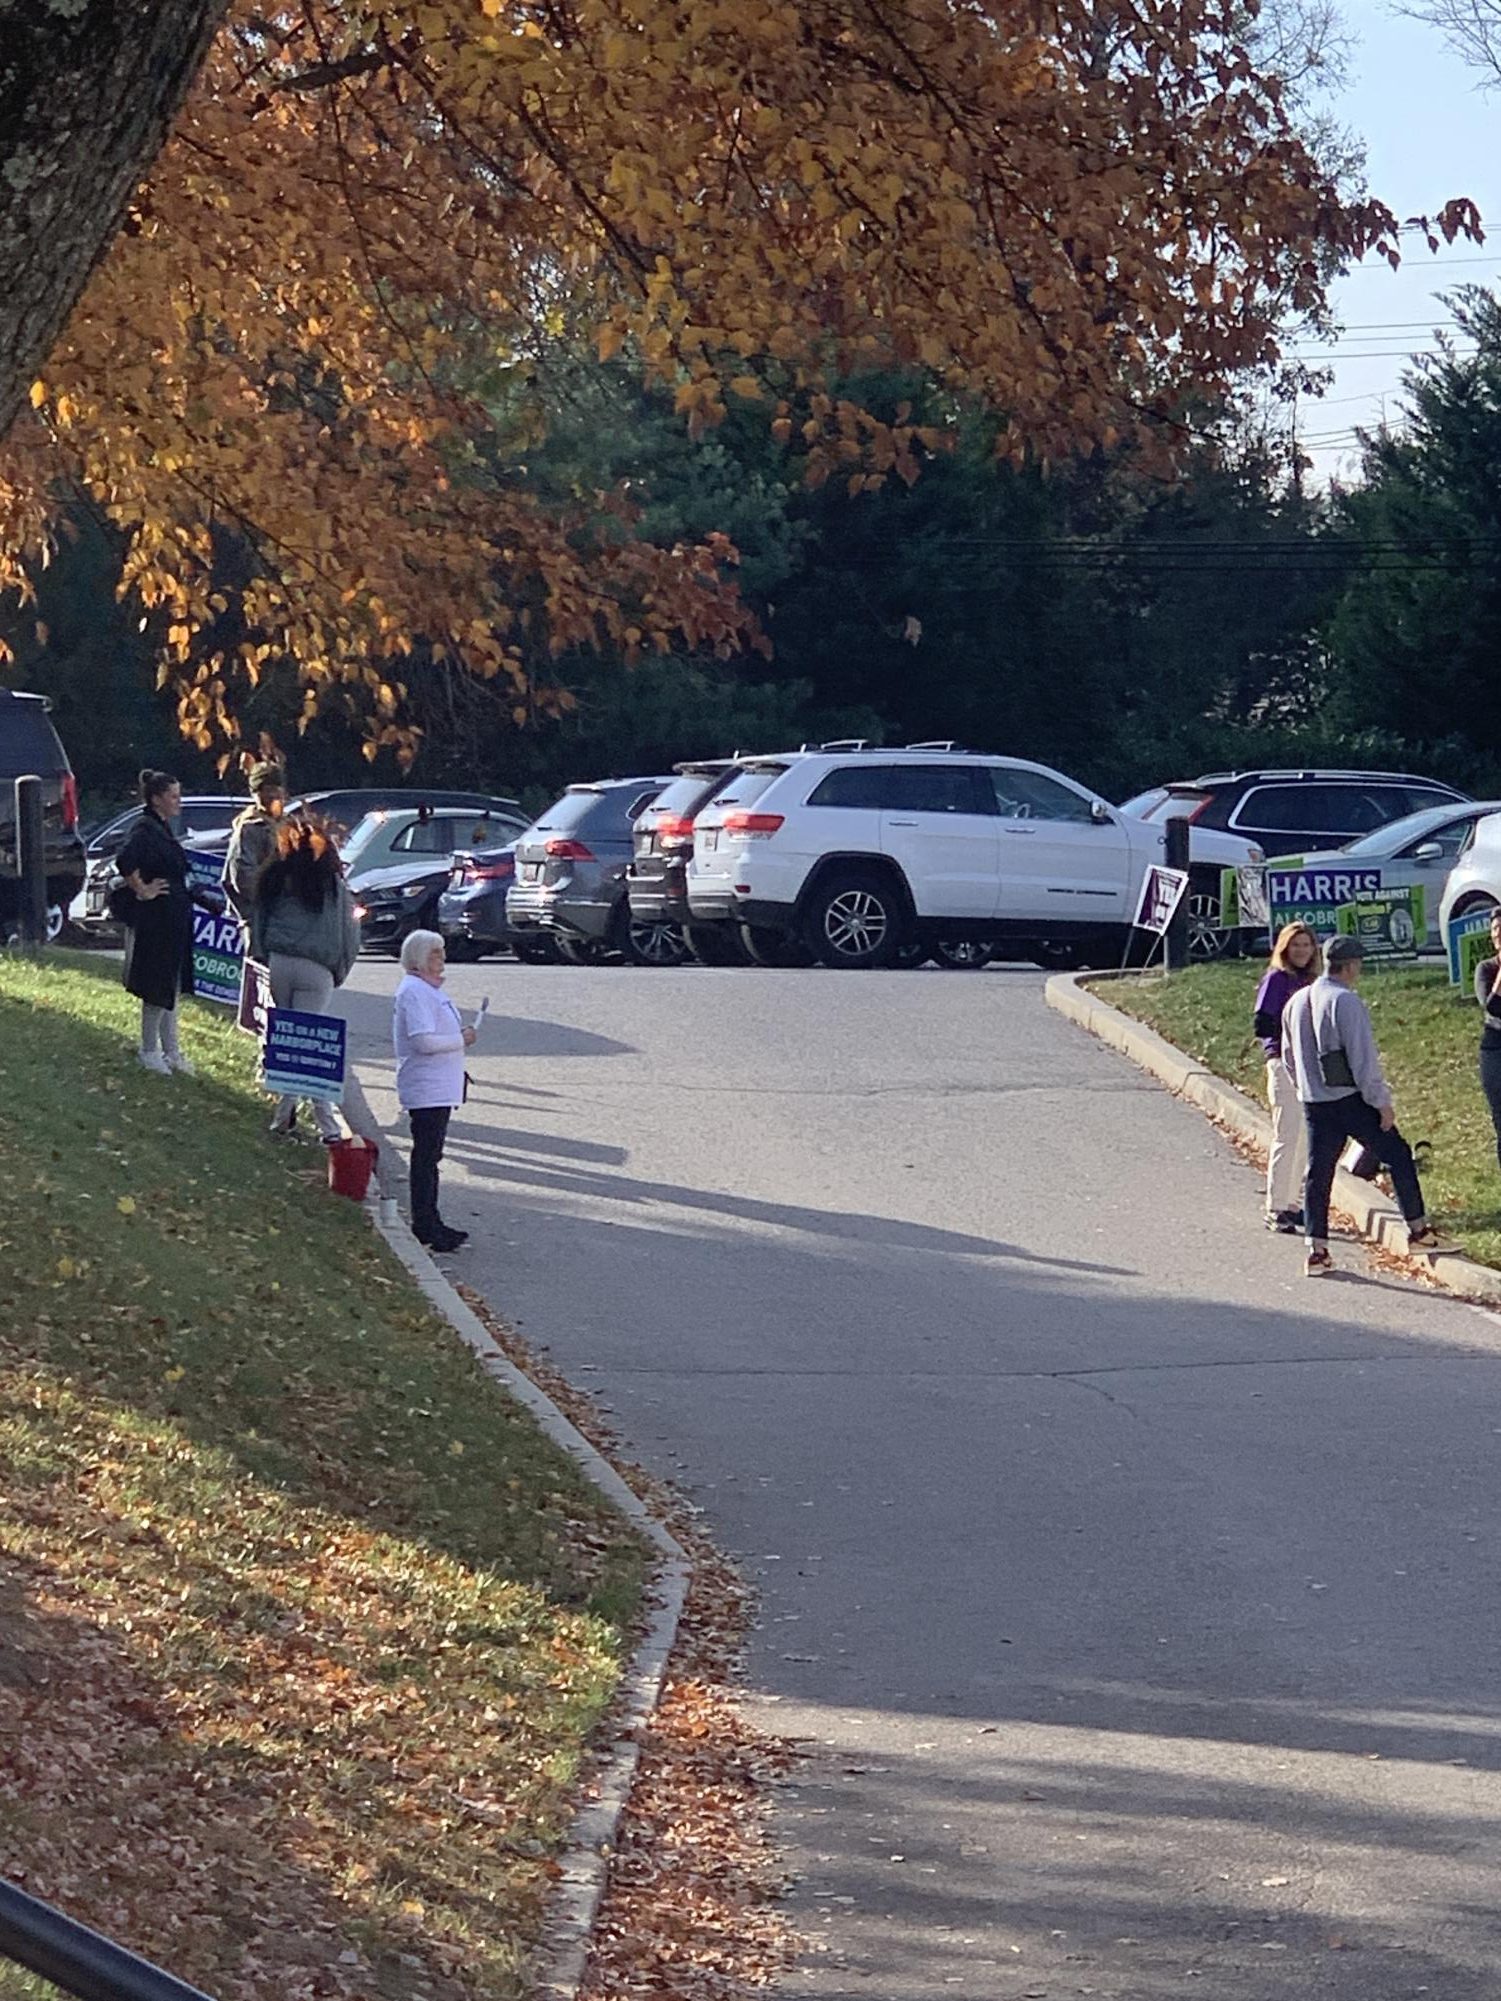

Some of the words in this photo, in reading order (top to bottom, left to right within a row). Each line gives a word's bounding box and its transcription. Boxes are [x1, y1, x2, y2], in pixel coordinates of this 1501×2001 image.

[1271, 875, 1378, 902] HARRIS
[275, 1020, 294, 1034] YES
[317, 1027, 339, 1041] NEW
